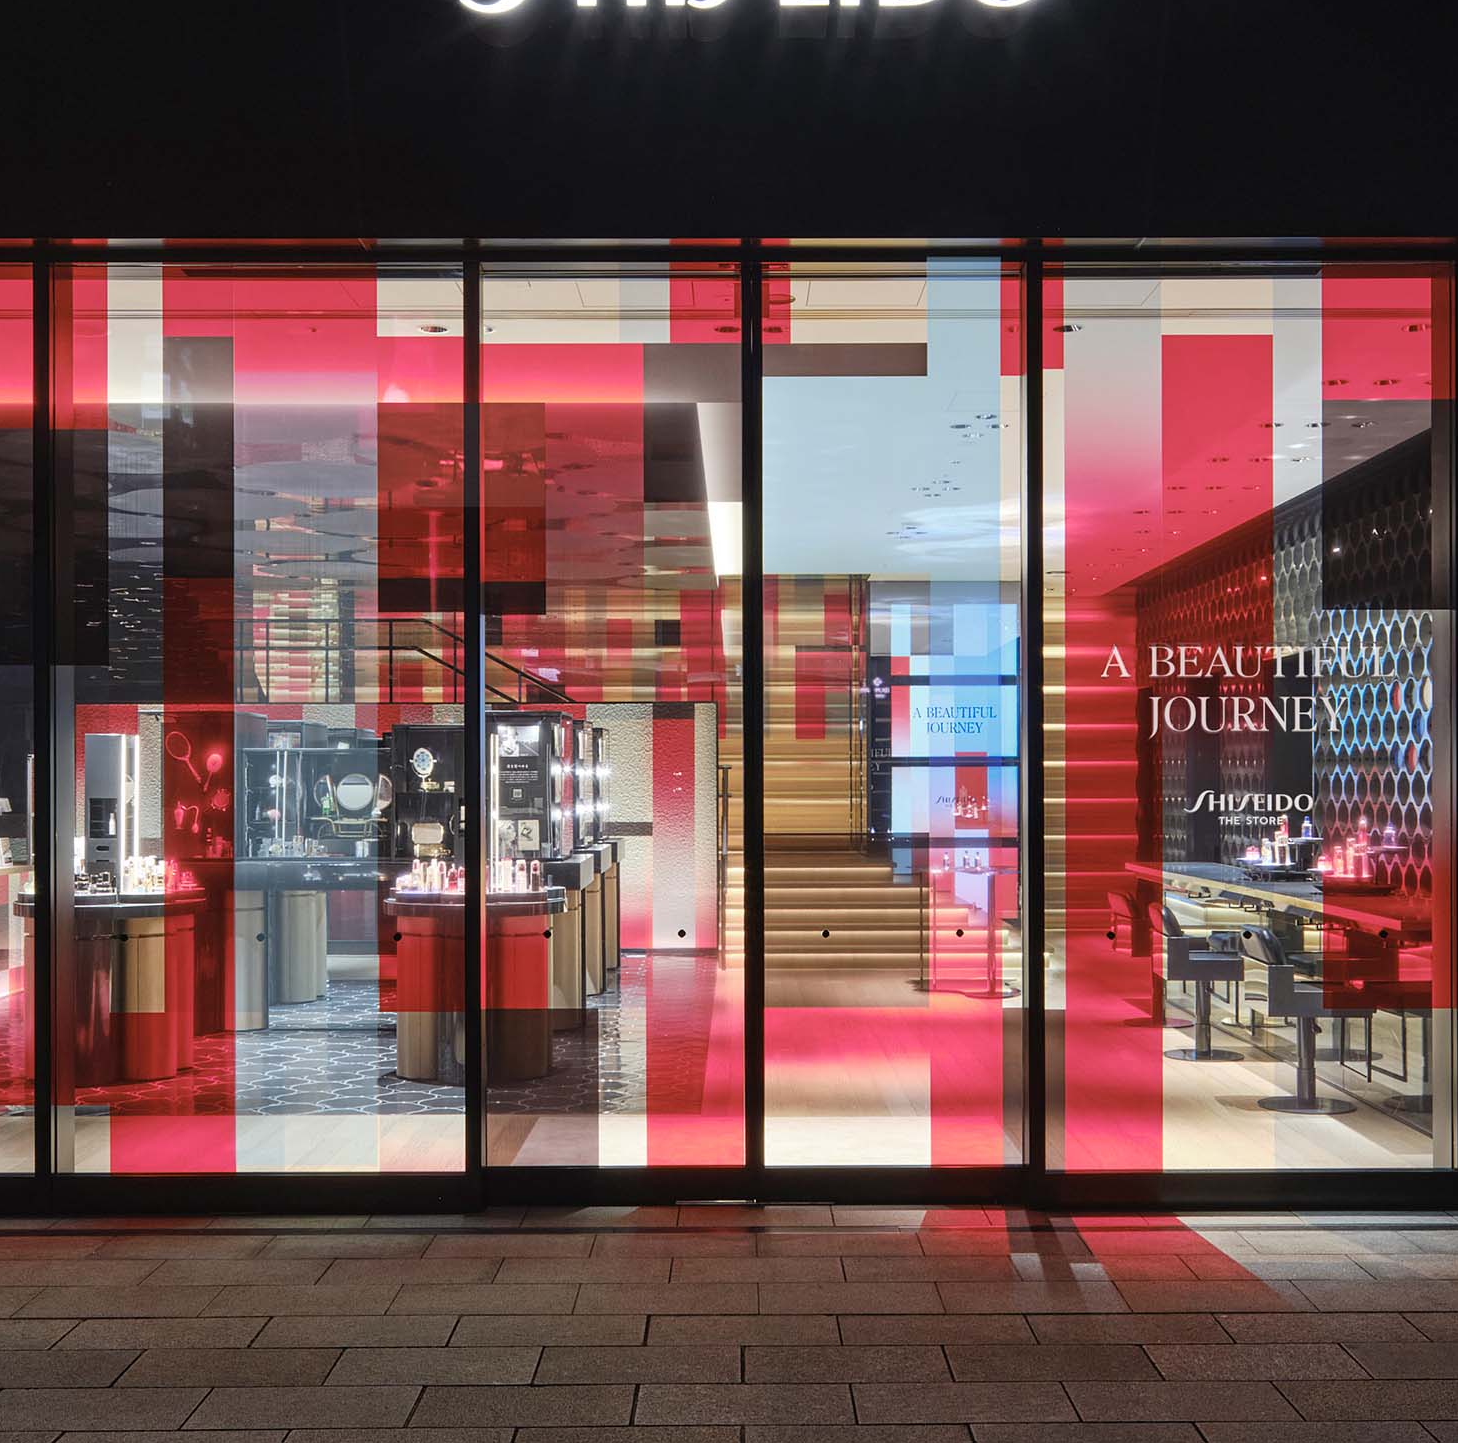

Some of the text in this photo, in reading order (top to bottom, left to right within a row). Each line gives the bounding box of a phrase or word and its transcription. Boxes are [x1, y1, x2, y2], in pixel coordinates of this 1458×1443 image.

[1100, 644, 1396, 679] A BEAUTIFUL
[911, 706, 998, 719] A BEAUTIFUL
[1148, 696, 1350, 740] JOURNEY
[926, 722, 983, 734] JOURNEY
[1183, 790, 1314, 813] SHISEIDO
[1218, 816, 1285, 826] THE STORE
